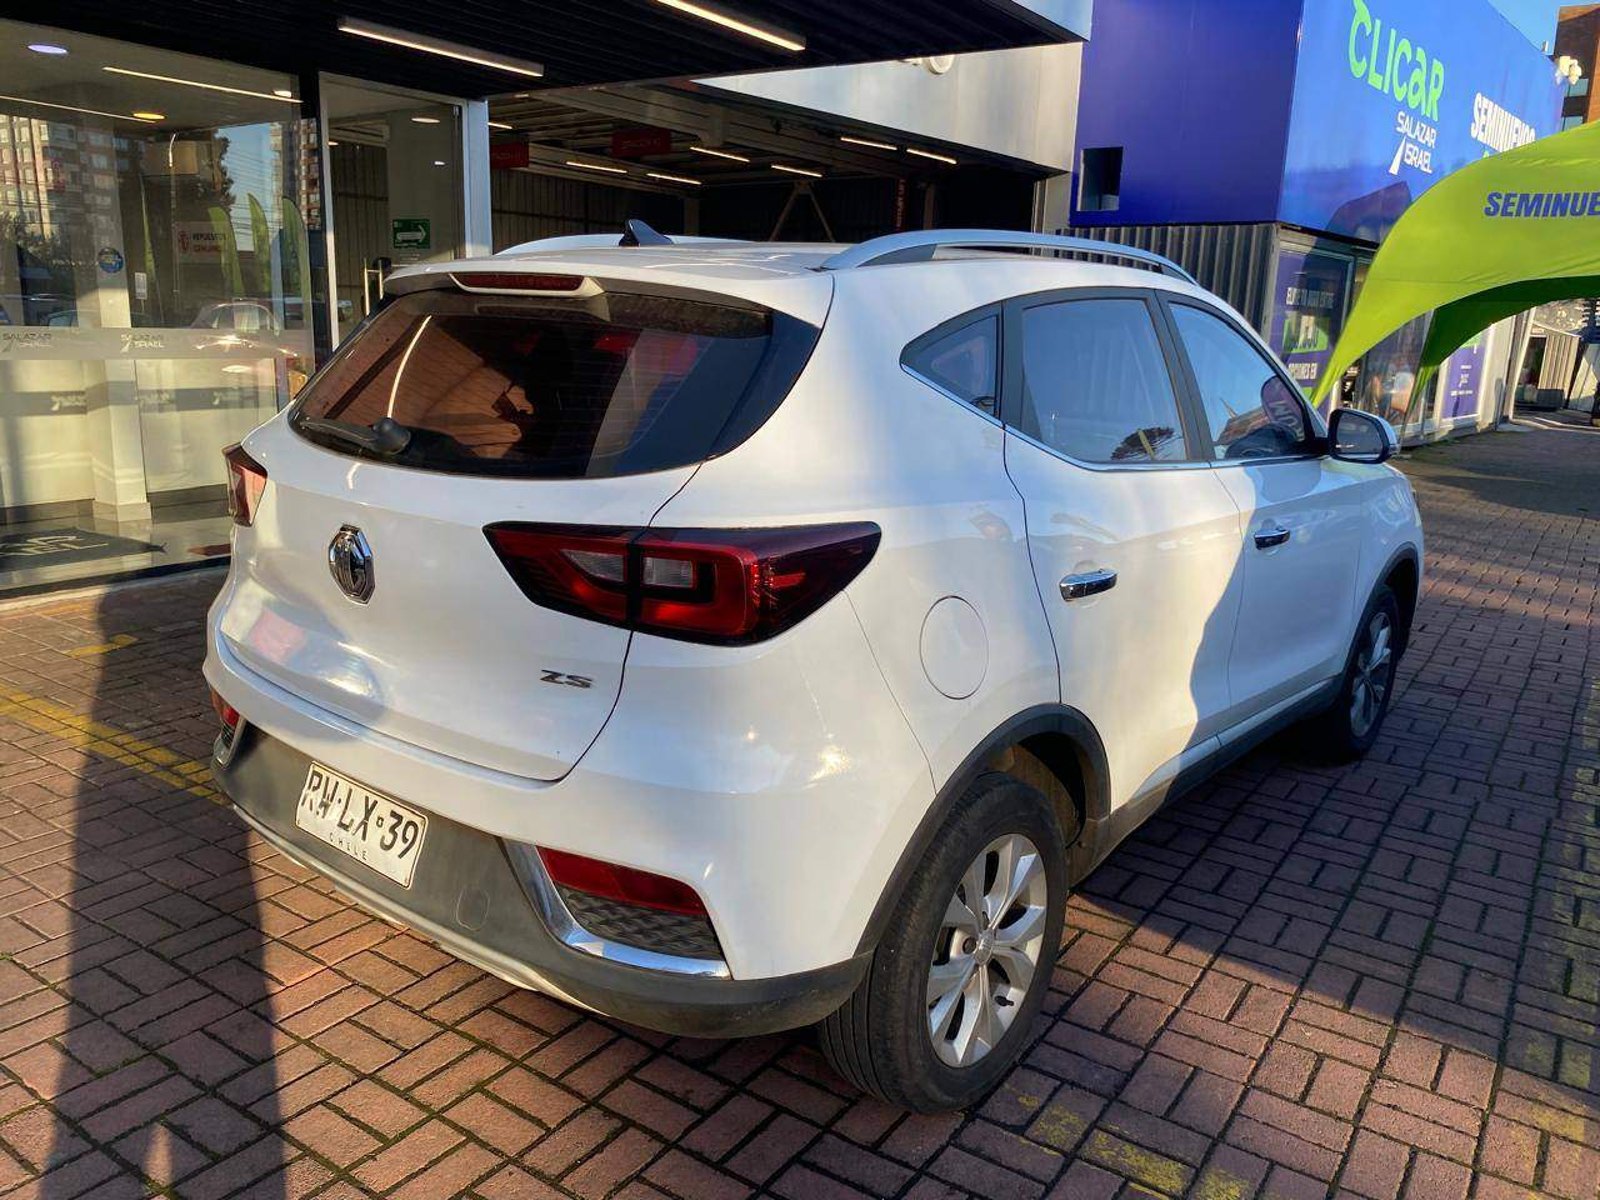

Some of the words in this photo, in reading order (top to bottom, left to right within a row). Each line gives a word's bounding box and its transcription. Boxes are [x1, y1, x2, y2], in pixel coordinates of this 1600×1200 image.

[1395, 110, 1437, 149] SALAZAR
[1388, 136, 1433, 175] ISRAEL
[540, 669, 593, 688] ZS
[329, 832, 367, 860] CHILE
